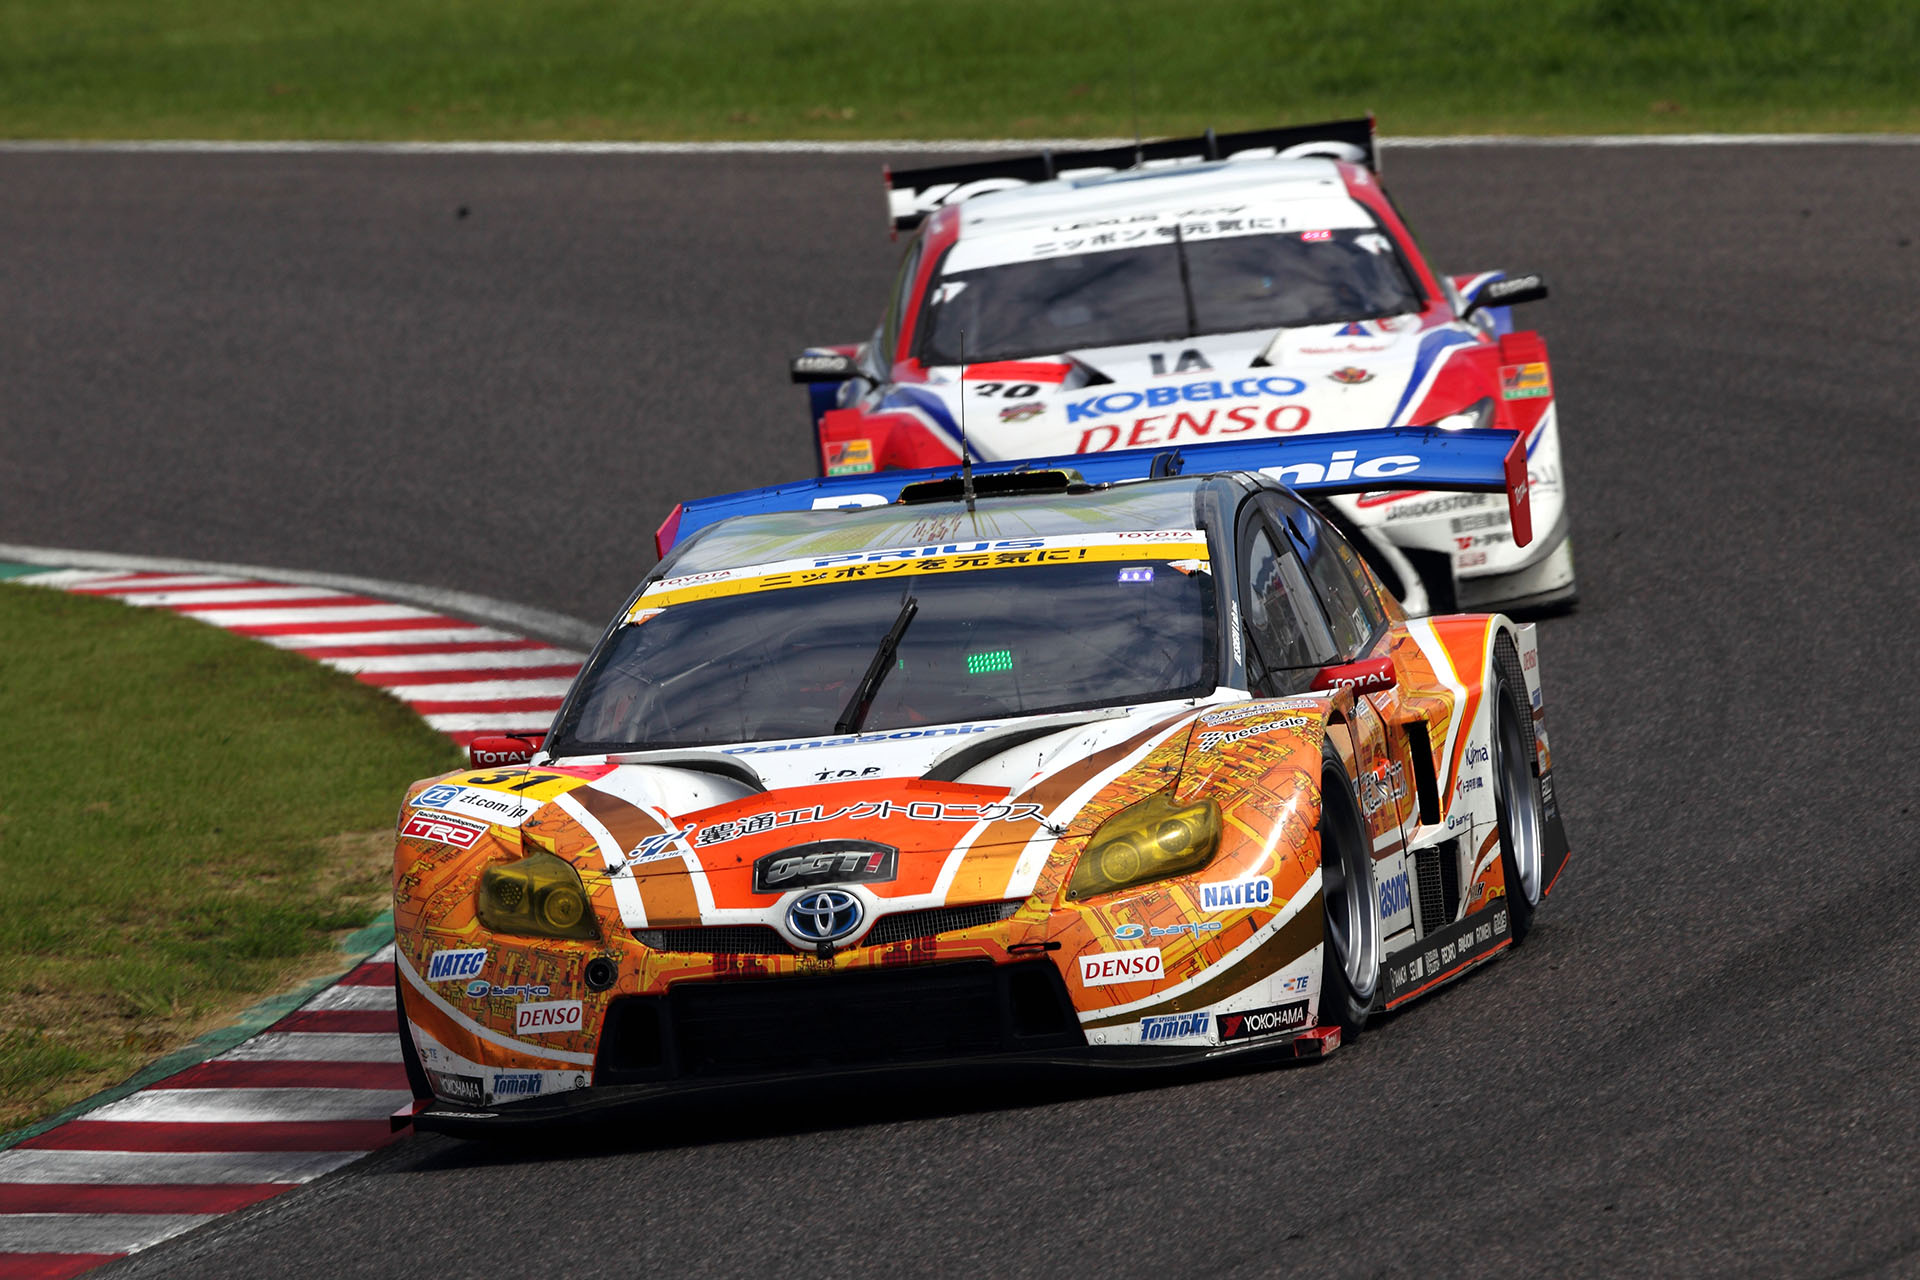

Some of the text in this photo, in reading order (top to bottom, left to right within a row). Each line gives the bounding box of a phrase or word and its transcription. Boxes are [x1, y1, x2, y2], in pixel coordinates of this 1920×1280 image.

[1065, 376, 1306, 423] KOBELCO
[1075, 404, 1311, 455] DENSO
[1116, 531, 1193, 539] TOYOTA
[814, 538, 1045, 567] PRIUS
[657, 570, 731, 588] TOYOTA
[759, 548, 1087, 588] ニッポンを元気に!
[1328, 671, 1391, 689] TOTAL
[720, 724, 1001, 755] Panasonic
[1223, 717, 1305, 743] freescale
[473, 750, 534, 764] TOTAL
[467, 769, 563, 792] 31
[460, 793, 529, 819] zf.com/jp
[412, 820, 474, 844] TRD
[416, 810, 486, 831] Racing Development
[1203, 880, 1270, 908] NATEC
[1150, 921, 1222, 940] sanko
[430, 951, 485, 978] NATEC
[1085, 955, 1160, 980] DENSO
[518, 1006, 581, 1028] DENSO
[1159, 1013, 1193, 1023] SPECIAL PARTS
[1243, 1006, 1304, 1033] YOKOHAMA
[439, 1077, 481, 1099] YOKOHAMA
